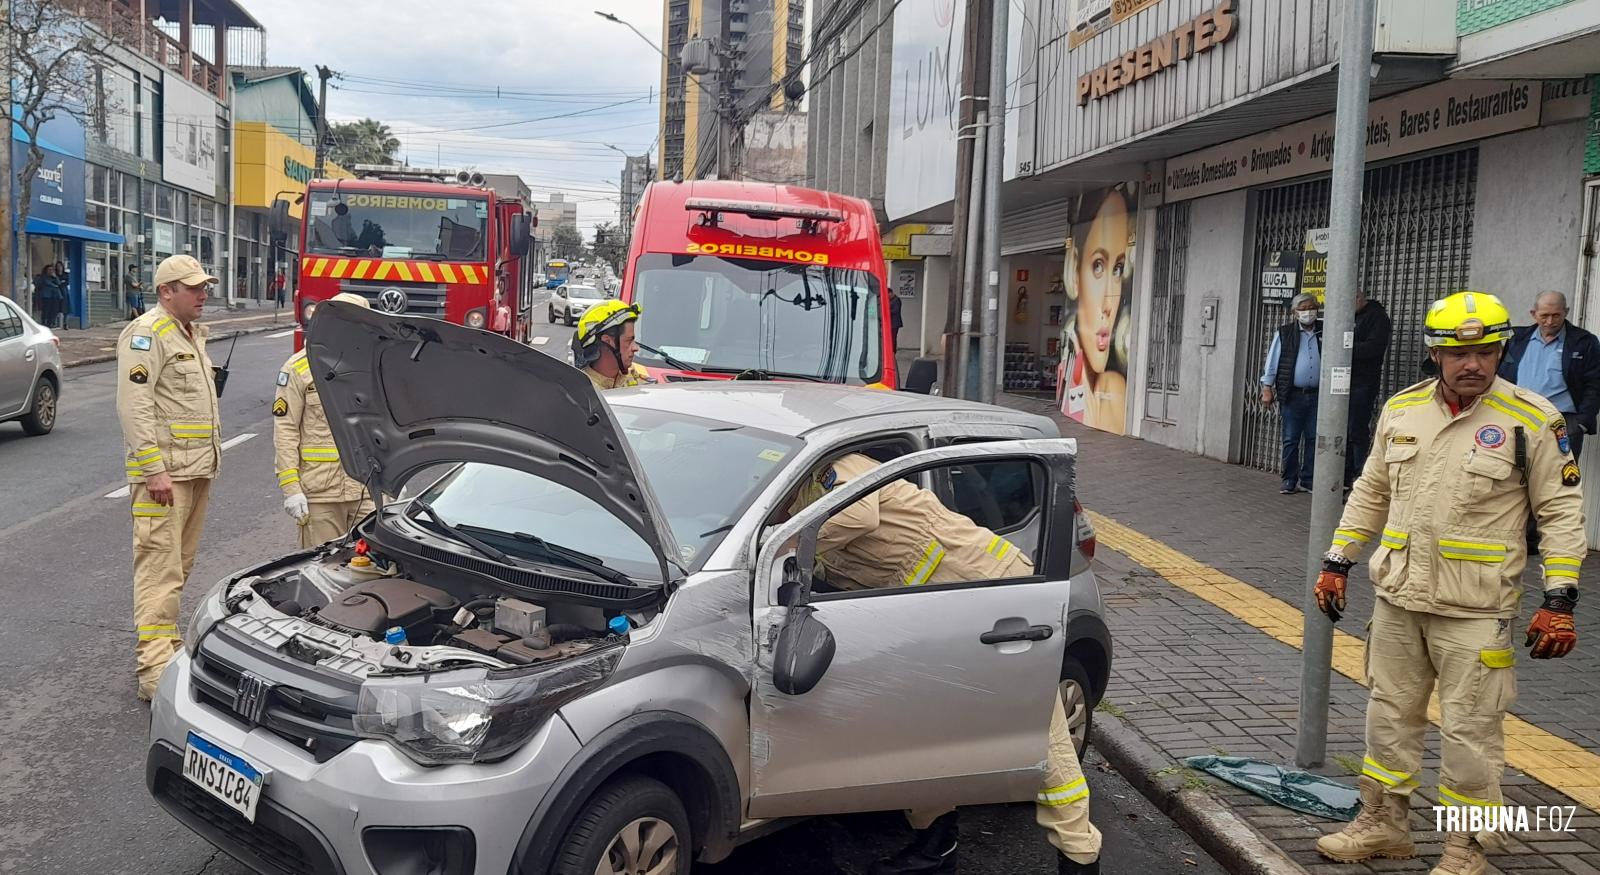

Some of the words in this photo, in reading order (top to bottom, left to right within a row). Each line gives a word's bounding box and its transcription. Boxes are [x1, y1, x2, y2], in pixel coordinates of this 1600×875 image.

[1077, 0, 1239, 106] PRESENTES
[1172, 165, 1200, 190] Utilidades
[1201, 157, 1238, 184] Domesticas
[1251, 141, 1292, 174] Brinquedos
[1310, 131, 1335, 162] Artig
[1366, 115, 1391, 147] oteis,
[1400, 109, 1430, 138] Bares
[1433, 108, 1440, 130] e
[1447, 83, 1529, 127] Restaurantes
[1263, 273, 1288, 286] ALUGA
[1305, 257, 1328, 273] ALUG
[218, 753, 233, 766] BRASIL
[189, 749, 252, 812] RNS1C84
